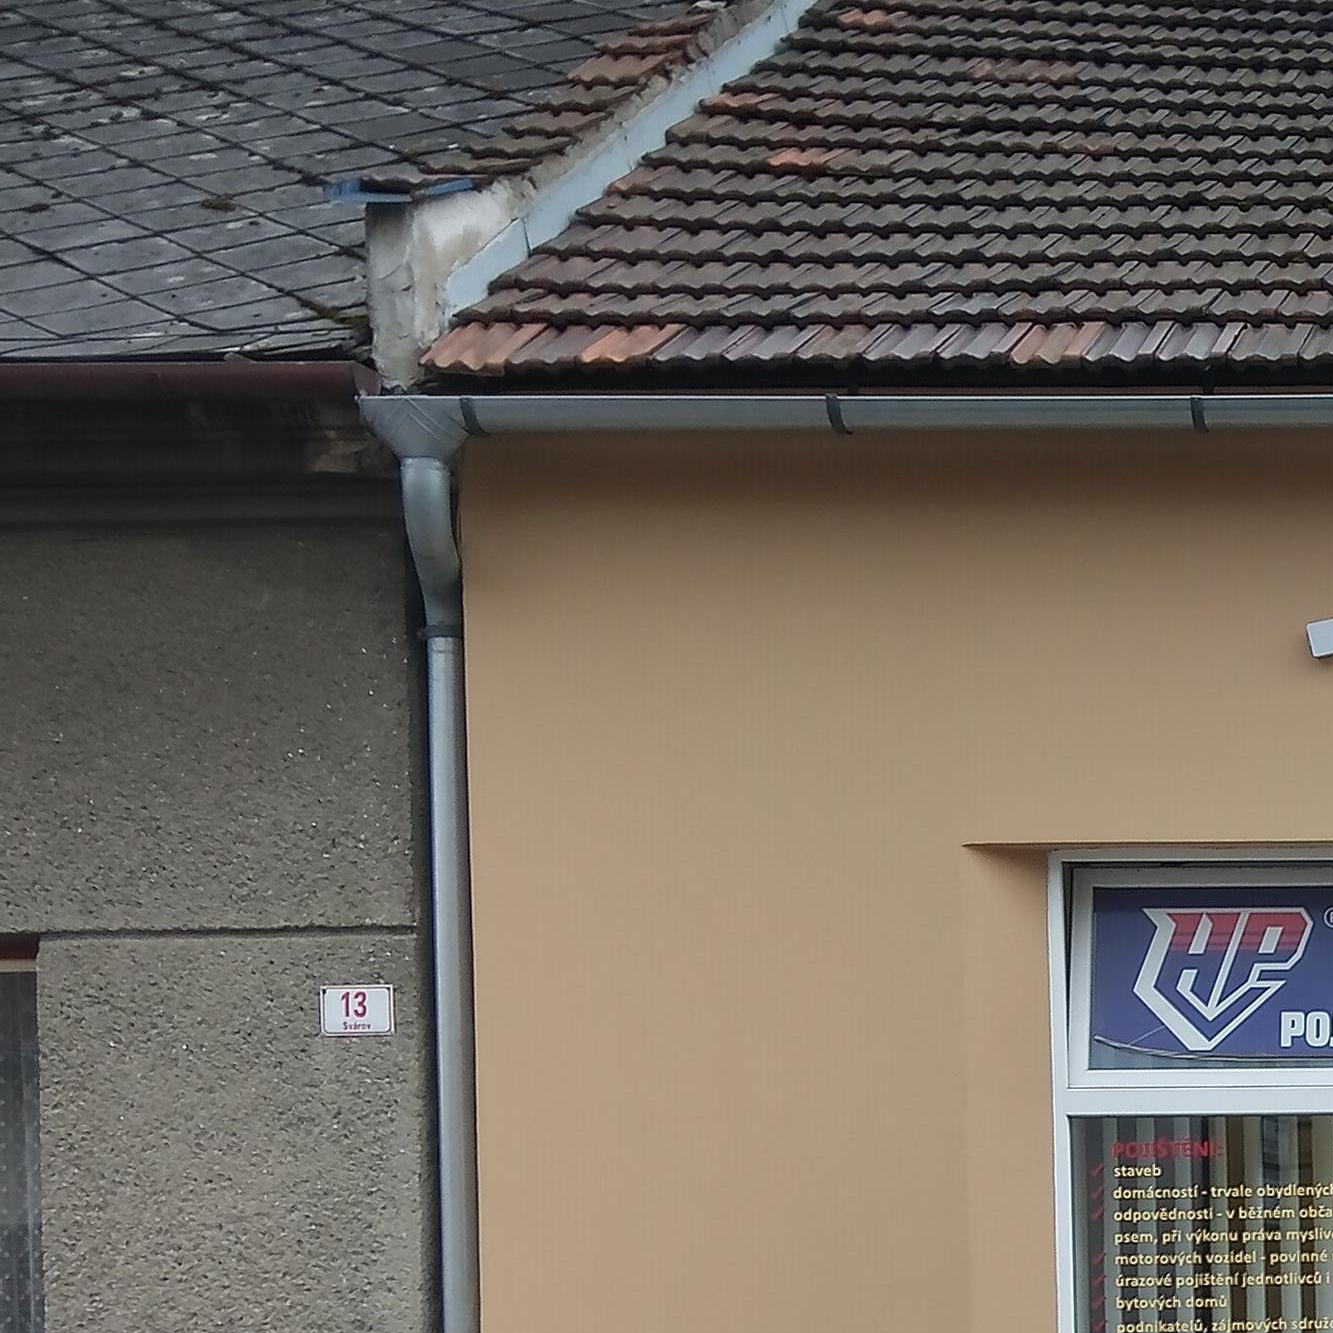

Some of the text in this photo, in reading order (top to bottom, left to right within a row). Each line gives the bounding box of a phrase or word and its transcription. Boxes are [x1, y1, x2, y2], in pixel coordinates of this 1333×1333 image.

[341, 991, 367, 1018] 13
[1113, 1164, 1162, 1178] staveb
[1113, 1184, 1198, 1200] domácností
[1210, 1184, 1252, 1198] trvale
[1226, 1209, 1236, 1219] v
[1238, 1206, 1294, 1219] běžném
[1114, 1232, 1158, 1245] psem,
[1162, 1229, 1181, 1244] při
[1186, 1229, 1238, 1244] výkonu
[1242, 1228, 1281, 1243] práva
[1115, 1250, 1201, 1266] motorových
[1206, 1248, 1256, 1264] vozidel
[1269, 1249, 1328, 1265] povinné
[1115, 1274, 1172, 1288] úrazové
[1175, 1271, 1238, 1289] pojištění
[1241, 1270, 1322, 1288] jednotlivců
[1115, 1295, 1227, 1313] bytových domů
[1212, 1317, 1287, 1333] zájmových
